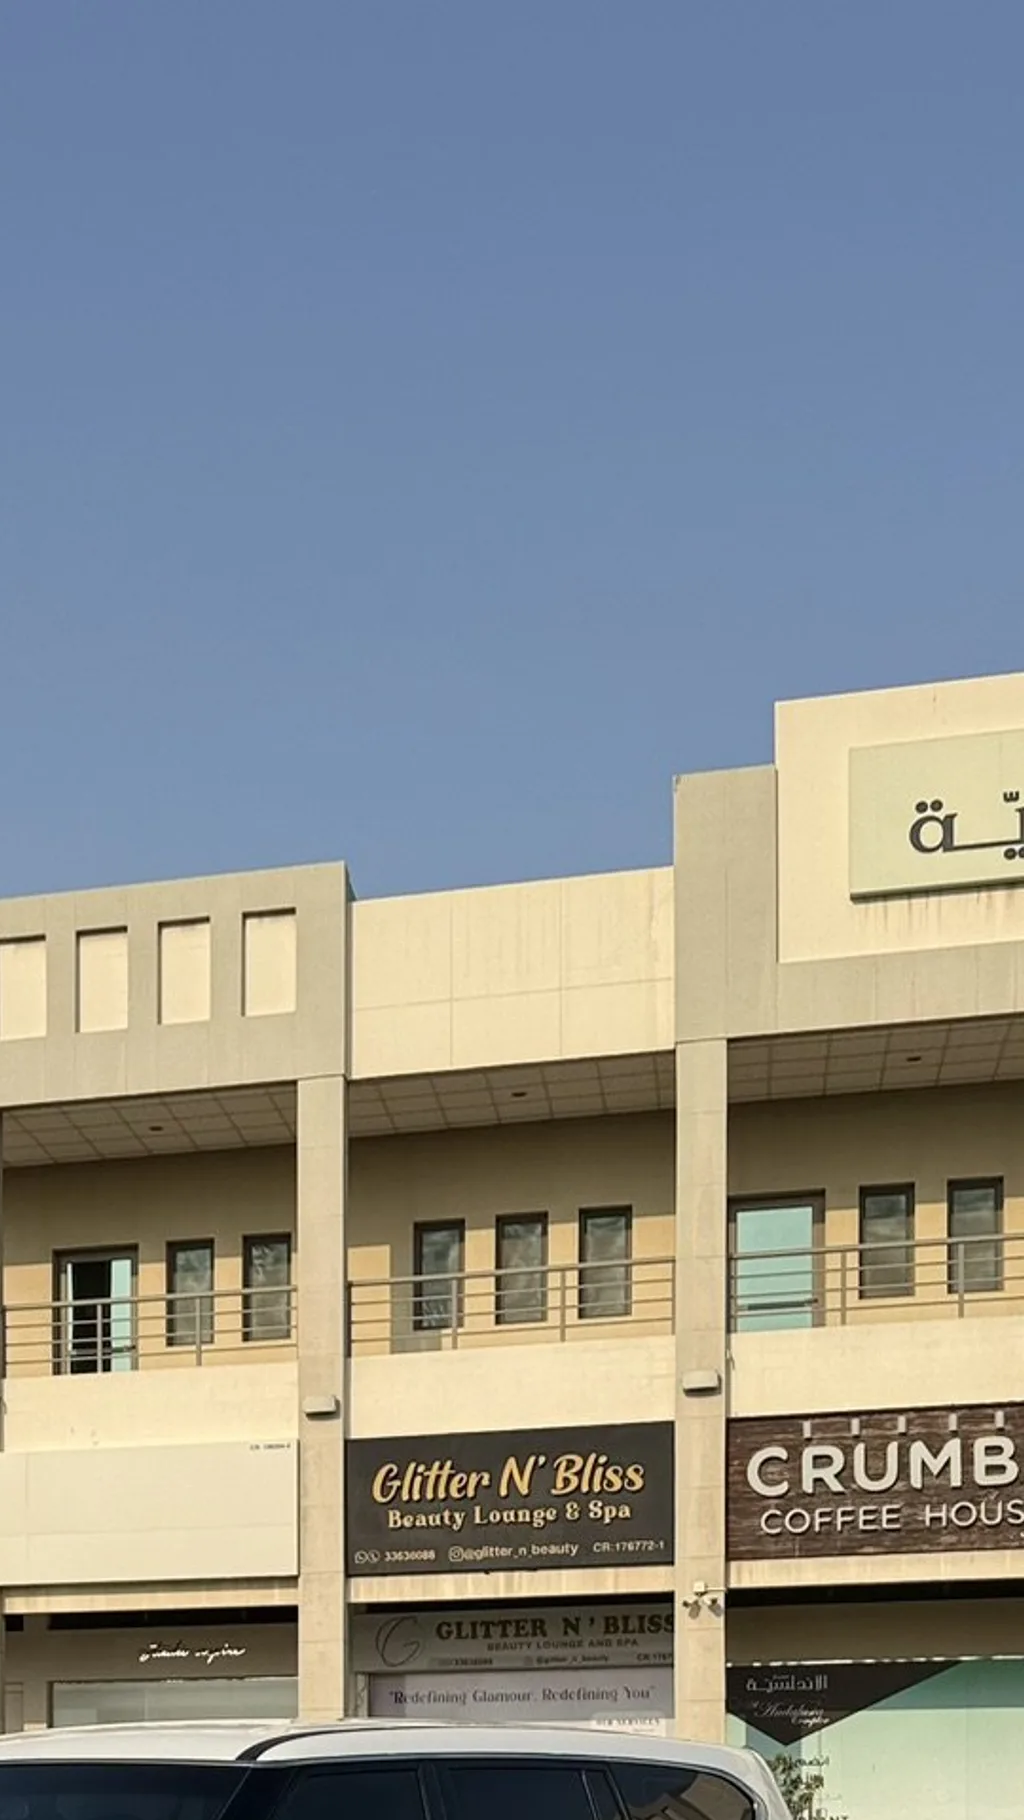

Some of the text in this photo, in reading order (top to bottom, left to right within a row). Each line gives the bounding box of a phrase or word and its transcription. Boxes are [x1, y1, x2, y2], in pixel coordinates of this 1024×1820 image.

[372, 1460, 490, 1503] Glitter
[551, 1452, 645, 1495] Bliss
[747, 1436, 1020, 1498] CRUMB
[387, 1500, 632, 1531] Beauty Lounge & Spa
[760, 1500, 1024, 1535] COFFEE HOUS
[435, 1619, 548, 1641] GLITTER
